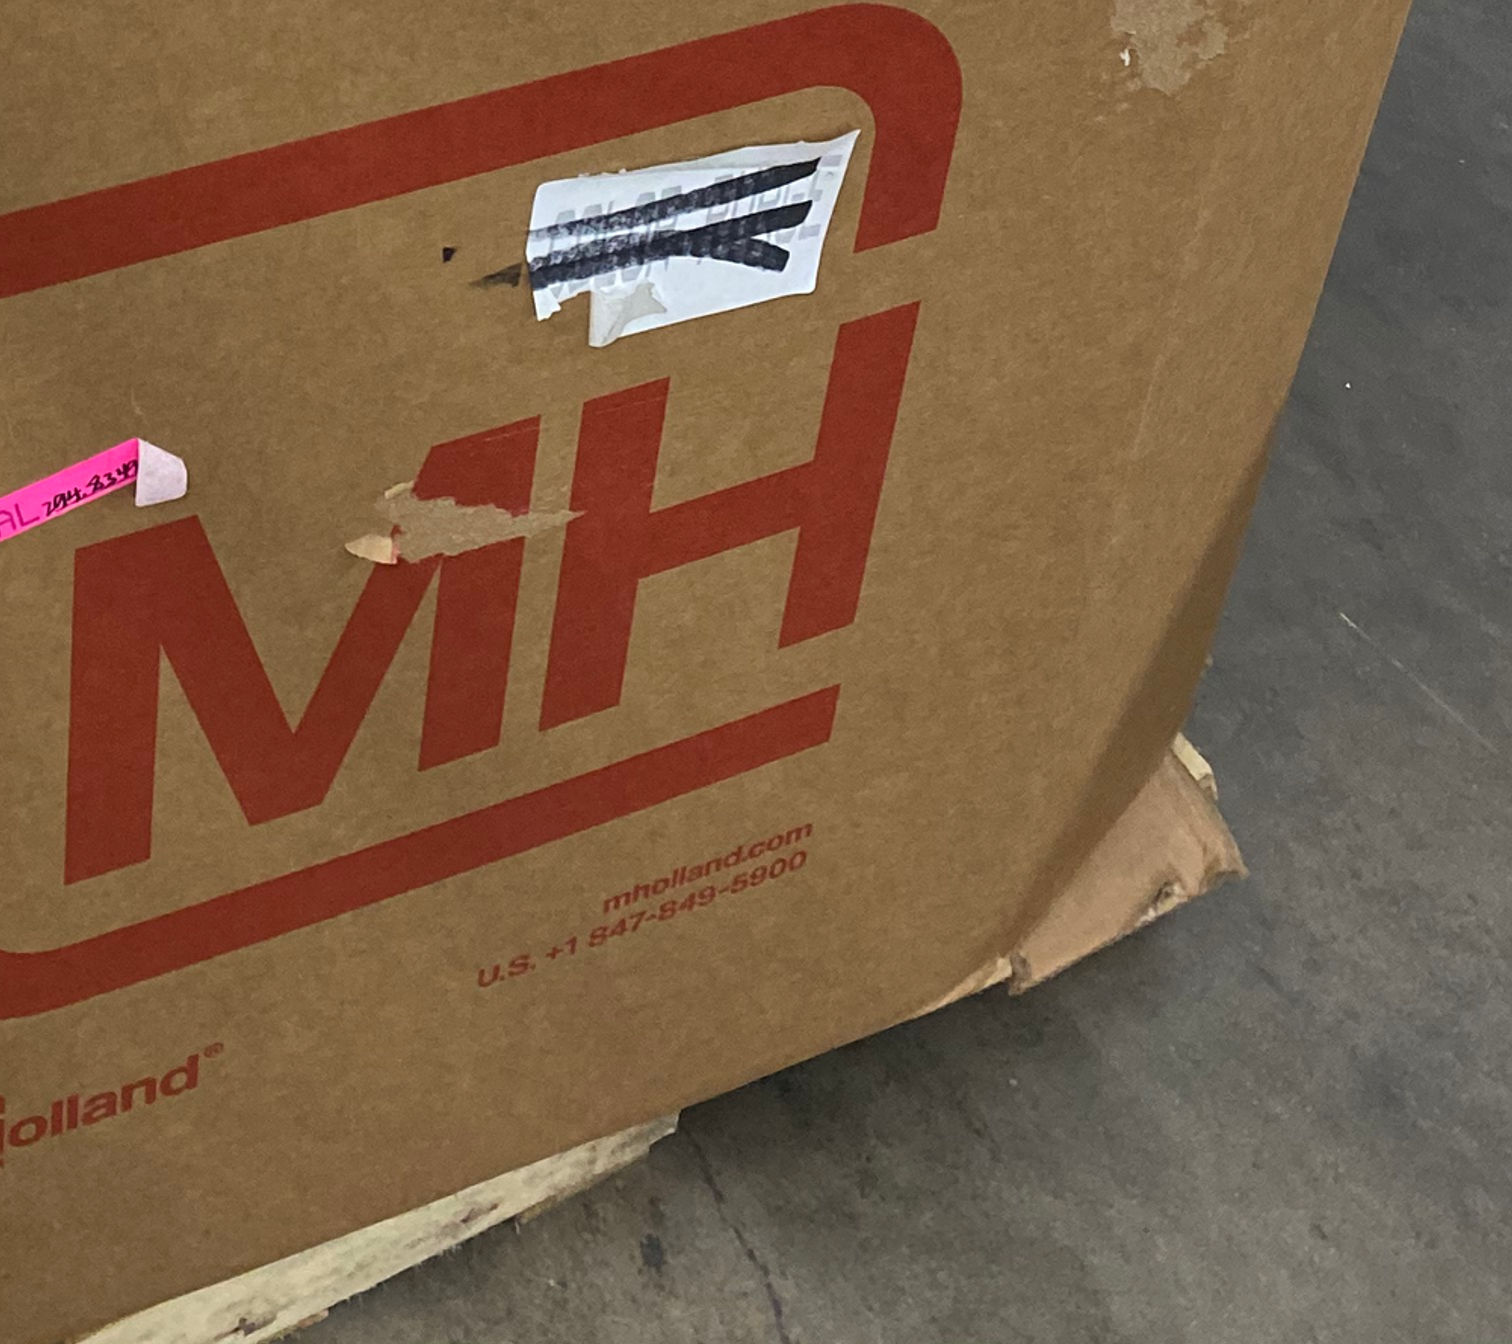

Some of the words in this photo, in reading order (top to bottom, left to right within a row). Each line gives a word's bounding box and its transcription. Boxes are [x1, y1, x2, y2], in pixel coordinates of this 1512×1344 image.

[64, 301, 920, 885] MH
[477, 954, 536, 987] U.S.
[545, 936, 578, 960] +1
[588, 850, 808, 948] 847-849-5900
[602, 822, 815, 914] mholland.com
